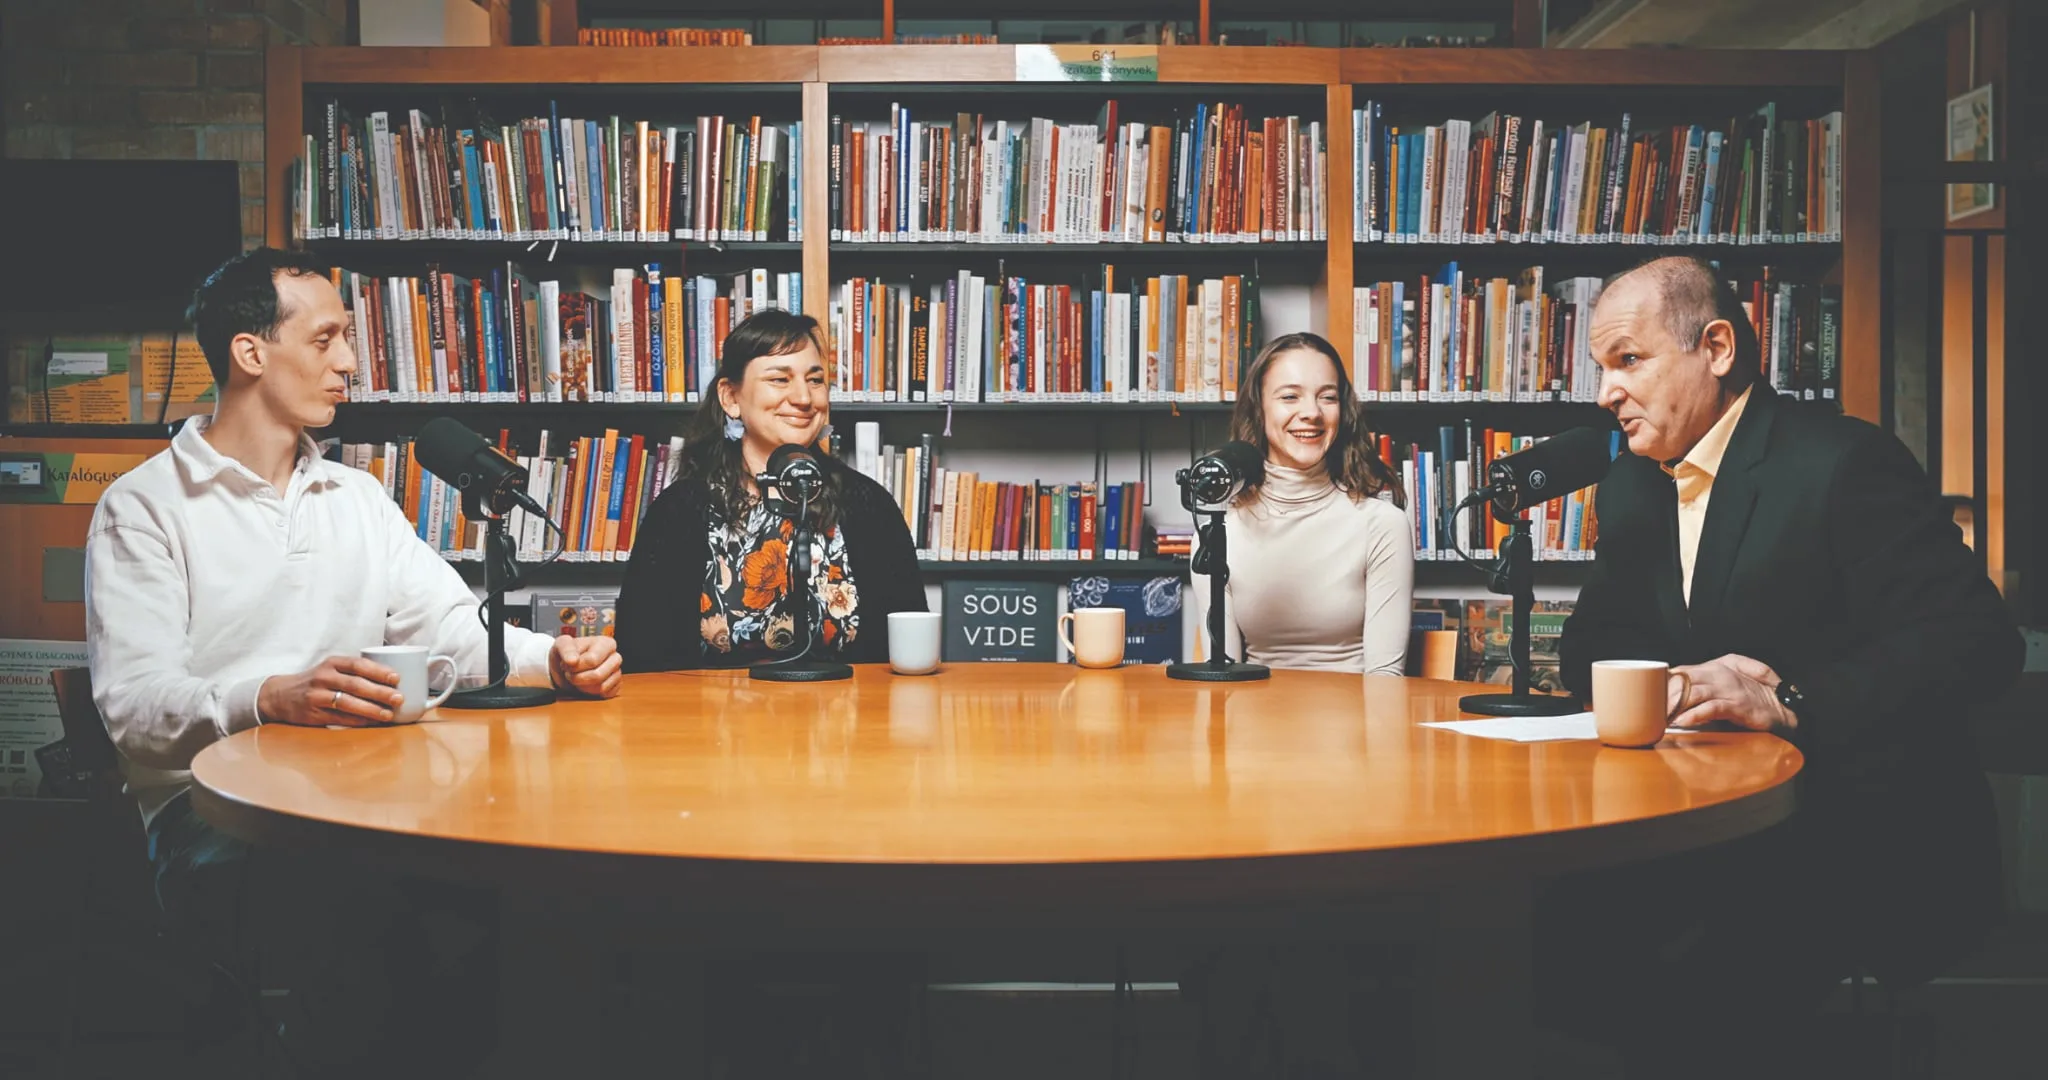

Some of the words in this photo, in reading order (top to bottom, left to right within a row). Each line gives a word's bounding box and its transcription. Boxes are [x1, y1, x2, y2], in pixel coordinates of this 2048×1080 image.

[1510, 117, 1522, 154] Gordon
[1277, 143, 1287, 185] LAWSON
[1503, 155, 1517, 198] Ramsay
[1277, 187, 1287, 227] NIGELLA
[917, 326, 928, 381] SIMPLISSIME
[1083, 518, 1091, 533] 500
[963, 594, 1038, 615] SOUS
[963, 626, 1036, 647] VIDE
